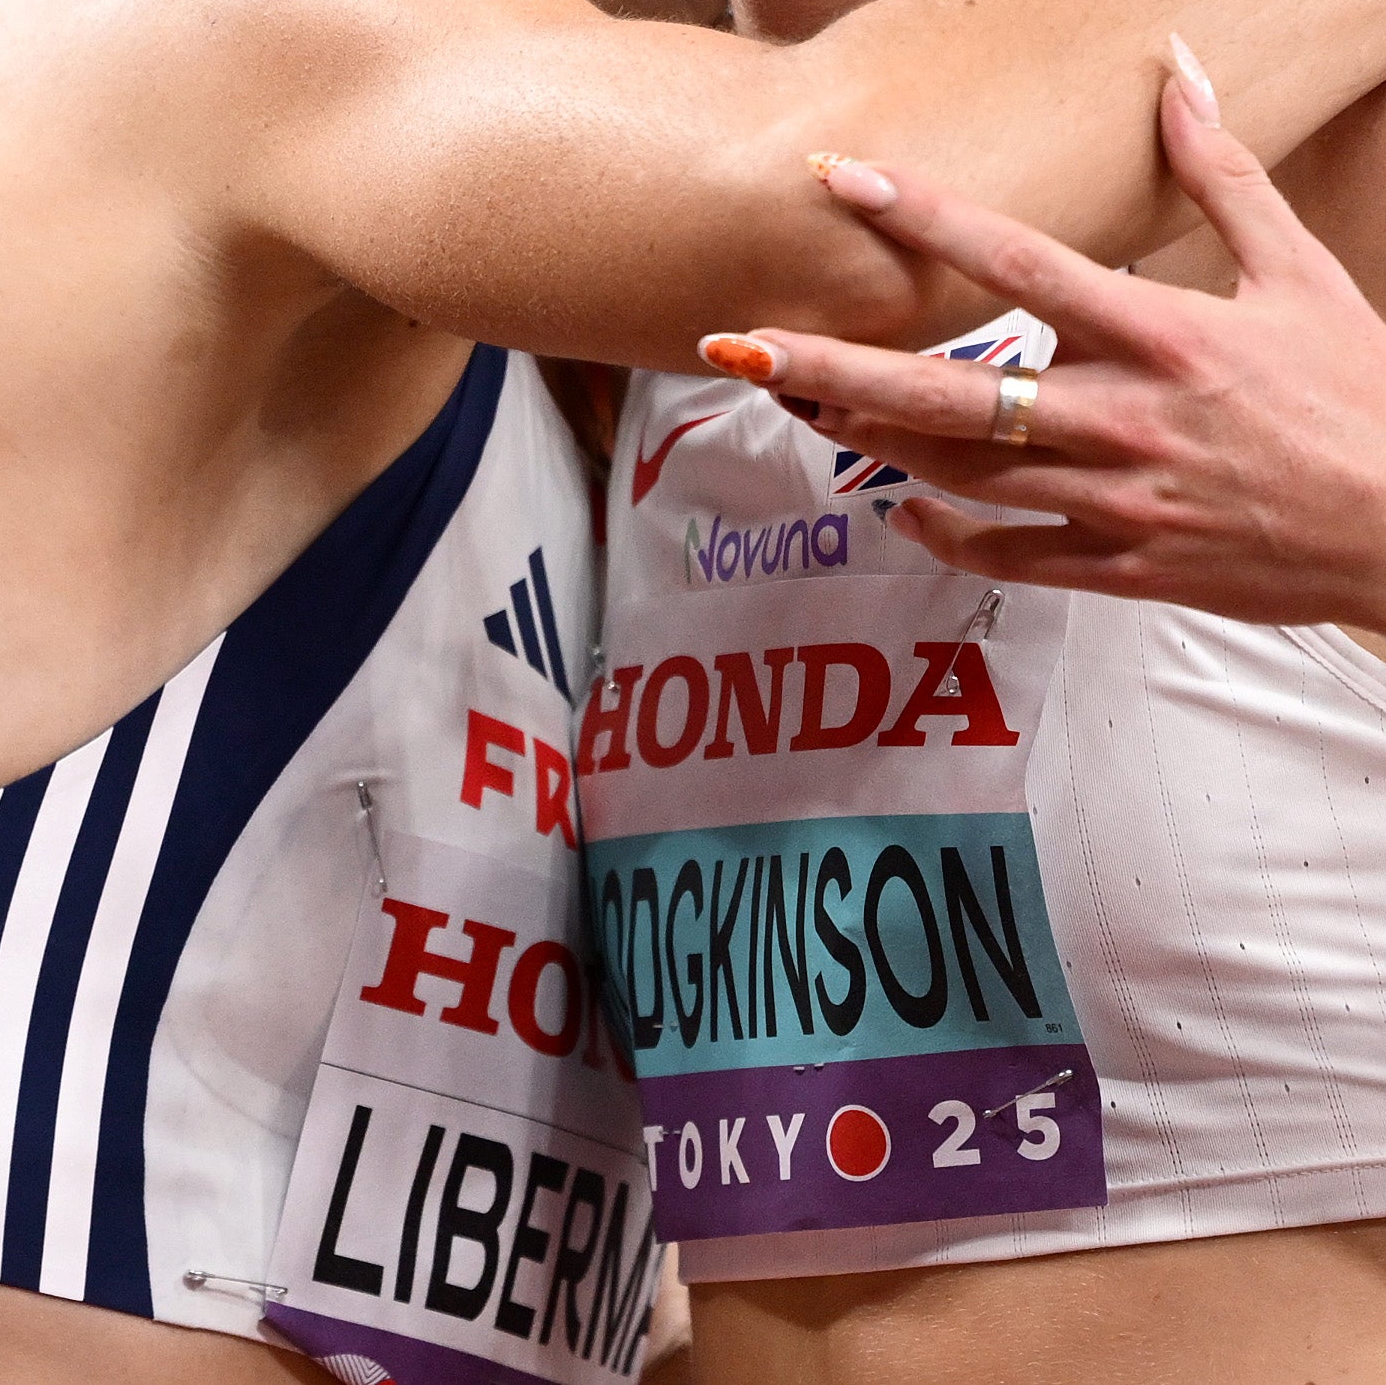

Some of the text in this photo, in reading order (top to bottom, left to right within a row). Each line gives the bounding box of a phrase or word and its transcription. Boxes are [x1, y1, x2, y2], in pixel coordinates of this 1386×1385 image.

[684, 513, 849, 584] Novuna
[576, 641, 1020, 776] HONDA
[596, 844, 1043, 1051] ODGKINSON
